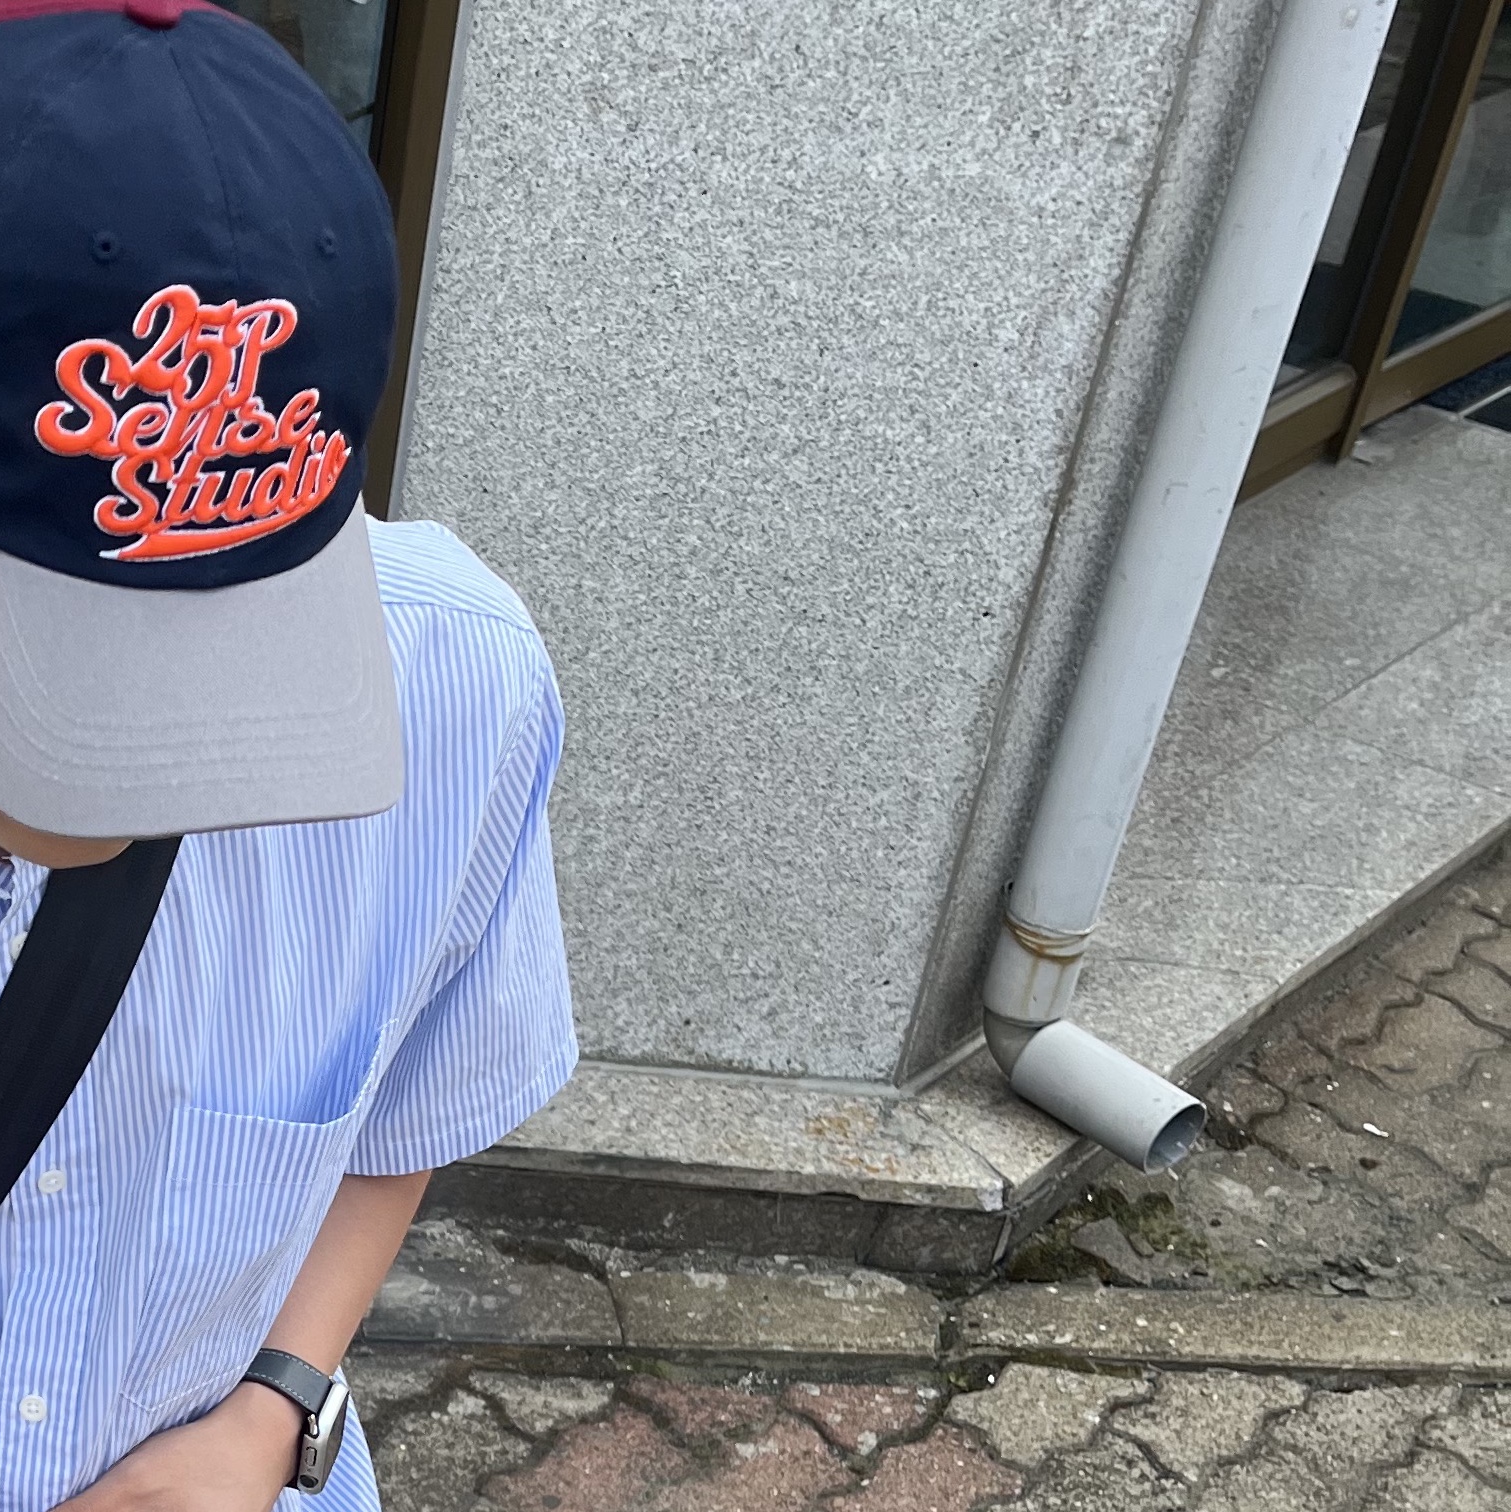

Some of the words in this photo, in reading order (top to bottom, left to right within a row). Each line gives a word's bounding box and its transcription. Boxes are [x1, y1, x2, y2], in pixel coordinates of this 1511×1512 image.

[35, 337, 321, 461] Sense
[131, 284, 299, 406] 25P
[94, 430, 352, 537] Studio
